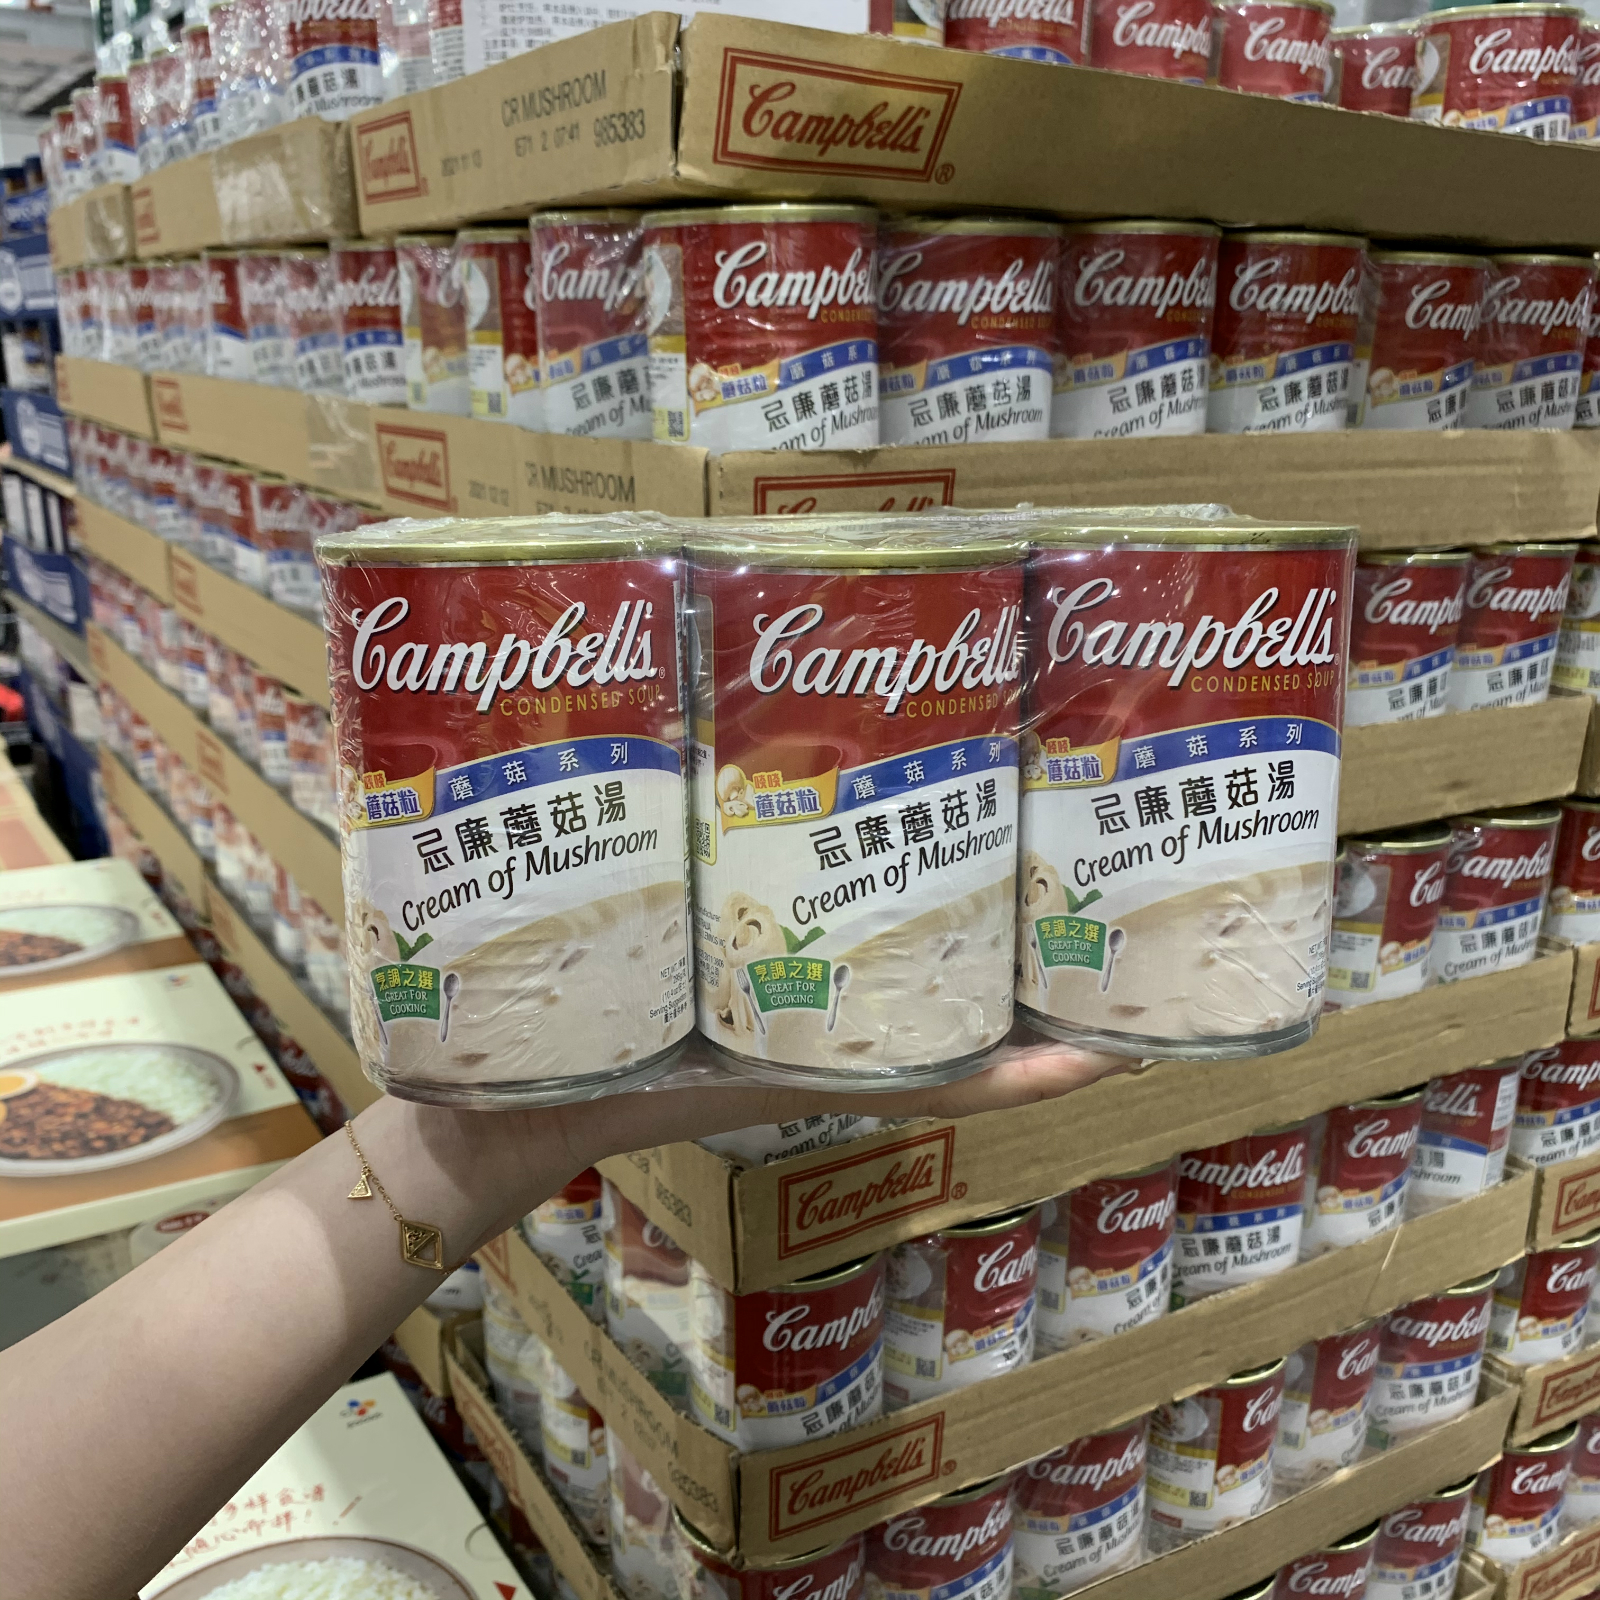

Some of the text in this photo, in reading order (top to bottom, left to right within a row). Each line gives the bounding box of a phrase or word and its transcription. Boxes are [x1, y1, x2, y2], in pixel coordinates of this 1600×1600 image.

[502, 69, 607, 127] CR MUSHROOM
[743, 81, 932, 158] Campbell's
[908, 374, 1032, 428] 忌廉蘑菇湯
[1148, 404, 1163, 430] of
[1294, 400, 1309, 426] of
[811, 420, 827, 446] of
[953, 416, 971, 440] of
[974, 405, 1043, 430] Mushroom
[541, 465, 636, 503] MUSHROOM
[1047, 577, 1337, 688] Campbell's
[351, 596, 659, 713] Campbell's
[1191, 669, 1335, 693] CONDENSED SOUP
[500, 684, 662, 716] CONDENSED SOUP
[906, 694, 998, 719] CONDENSED
[1133, 722, 1303, 770] 蘑菇系列
[447, 742, 629, 803] 蘑菇系列
[851, 740, 1002, 801] 蘑菇系列
[1046, 755, 1102, 783] 蘑菇粒
[365, 788, 420, 823] 蘑菇粒
[755, 788, 820, 818] 蘑菇粒
[1091, 760, 1295, 836] 忌廉蘑菇湯
[412, 780, 627, 875] 忌廉蘑菇湯
[810, 777, 997, 871] 忌廉蘑菇湯
[1074, 809, 1319, 888] Cream of Mushroom
[402, 828, 658, 932] Cream of Mushroom
[792, 823, 1013, 925] Cream of Mushroom
[1040, 919, 1100, 943] 烹調之選
[1048, 939, 1092, 951] GREAT FOR
[754, 961, 823, 985] 烹調之選
[1052, 952, 1090, 964] COOKING
[1444, 956, 1488, 977] Cream
[1490, 948, 1503, 967] of
[375, 968, 434, 992] 烹調之選
[765, 981, 816, 995] GREAT FOR
[385, 990, 428, 1003] GREAT FOR
[390, 1003, 427, 1016] COOKING
[770, 994, 814, 1007] COOKING
[819, 1122, 835, 1146] of
[796, 1153, 936, 1231] Campbell's
[1214, 1256, 1228, 1275] of
[1231, 1244, 1291, 1269] Mushroom
[787, 1437, 927, 1516] Campbell's
